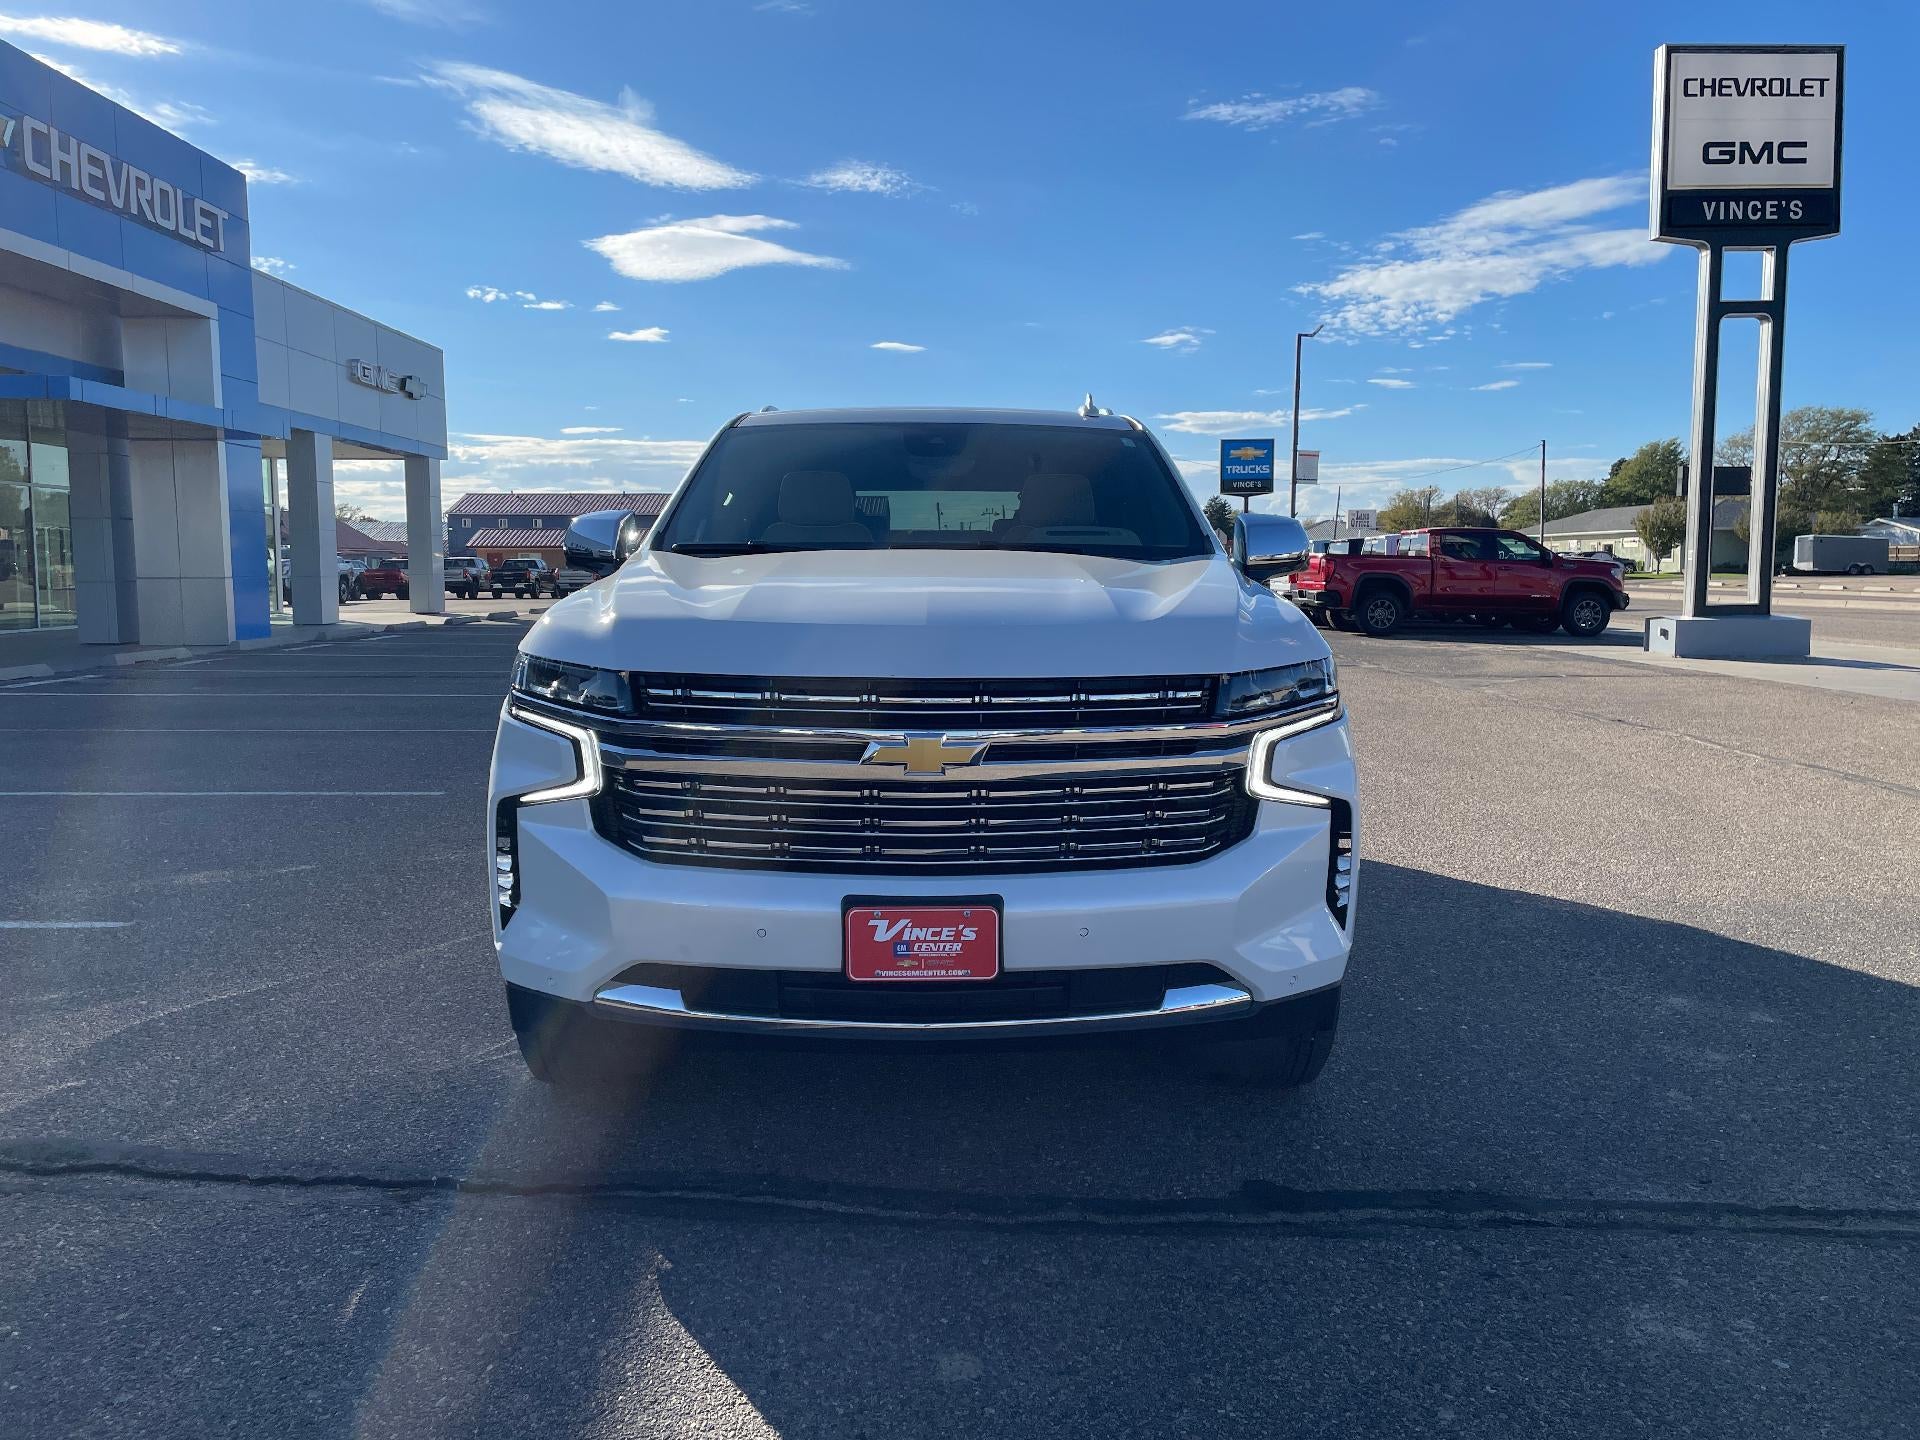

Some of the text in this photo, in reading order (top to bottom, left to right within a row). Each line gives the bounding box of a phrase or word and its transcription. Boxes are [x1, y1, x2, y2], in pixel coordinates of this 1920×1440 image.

[1683, 77, 1830, 98] CHEVROLET
[1702, 141, 1808, 165] GMC
[23, 115, 229, 253] CHEVROLET
[1702, 200, 1803, 221] VINCE'S
[357, 359, 400, 394] GMC
[1225, 464, 1270, 474] TRUCKS
[1232, 480, 1262, 489] VINCE'S
[913, 942, 963, 952] CENTER
